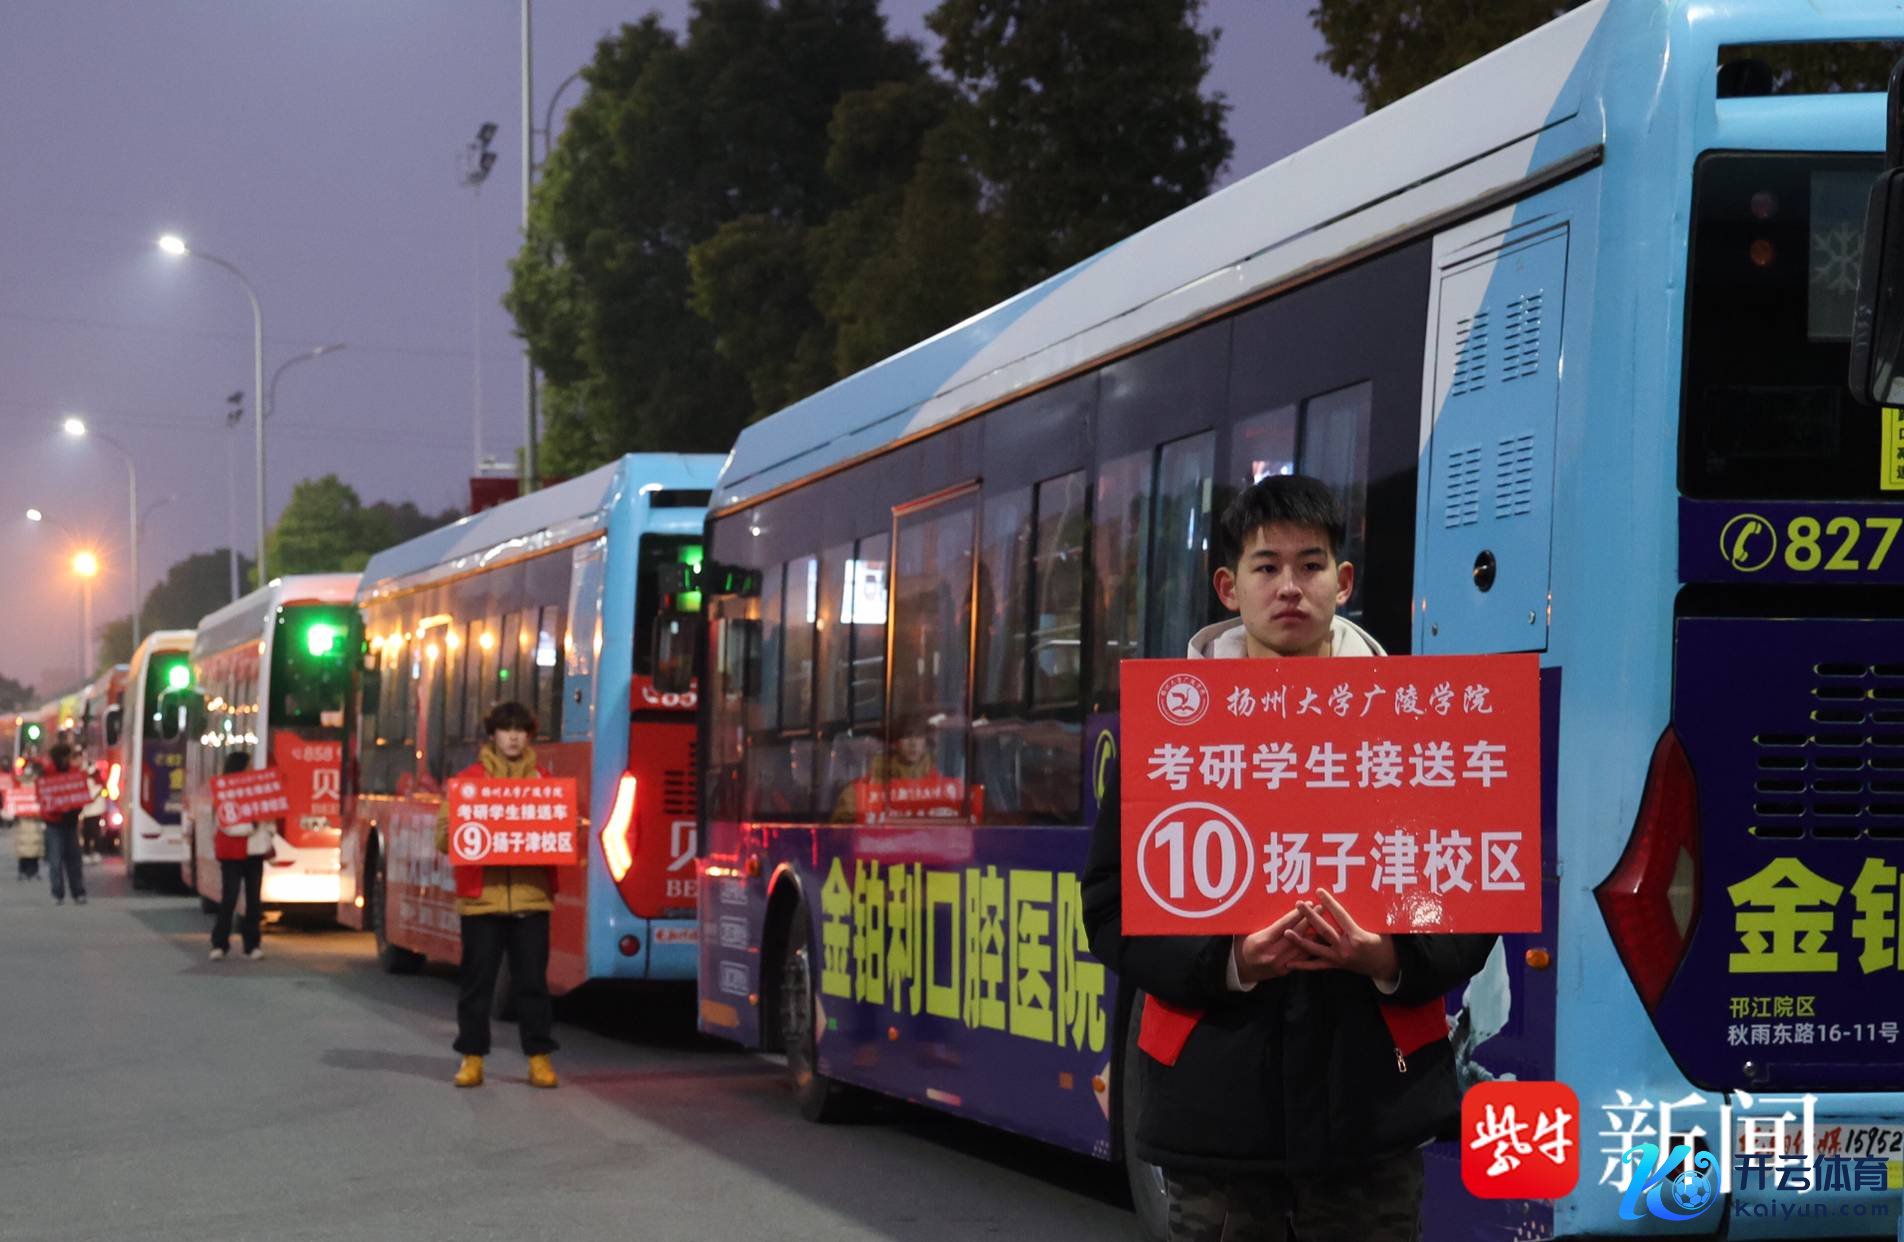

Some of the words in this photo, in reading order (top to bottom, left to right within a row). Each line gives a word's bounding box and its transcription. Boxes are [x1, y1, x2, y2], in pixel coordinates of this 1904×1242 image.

[1784, 516, 1903, 571] 827
[1226, 681, 1493, 719] 扬州大学广陵学院
[1147, 741, 1508, 790] 考研学生接送车
[457, 803, 568, 820] 考研学生接送车
[492, 831, 574, 854] 扬子津校区
[1151, 815, 1240, 904] 10
[1263, 829, 1526, 894] 扬子津校区
[820, 856, 1107, 1053] 金铂利口腔医院
[1728, 996, 1816, 1019] 邗江院区
[1727, 1021, 1900, 1047] 秋雨东路16-11号
